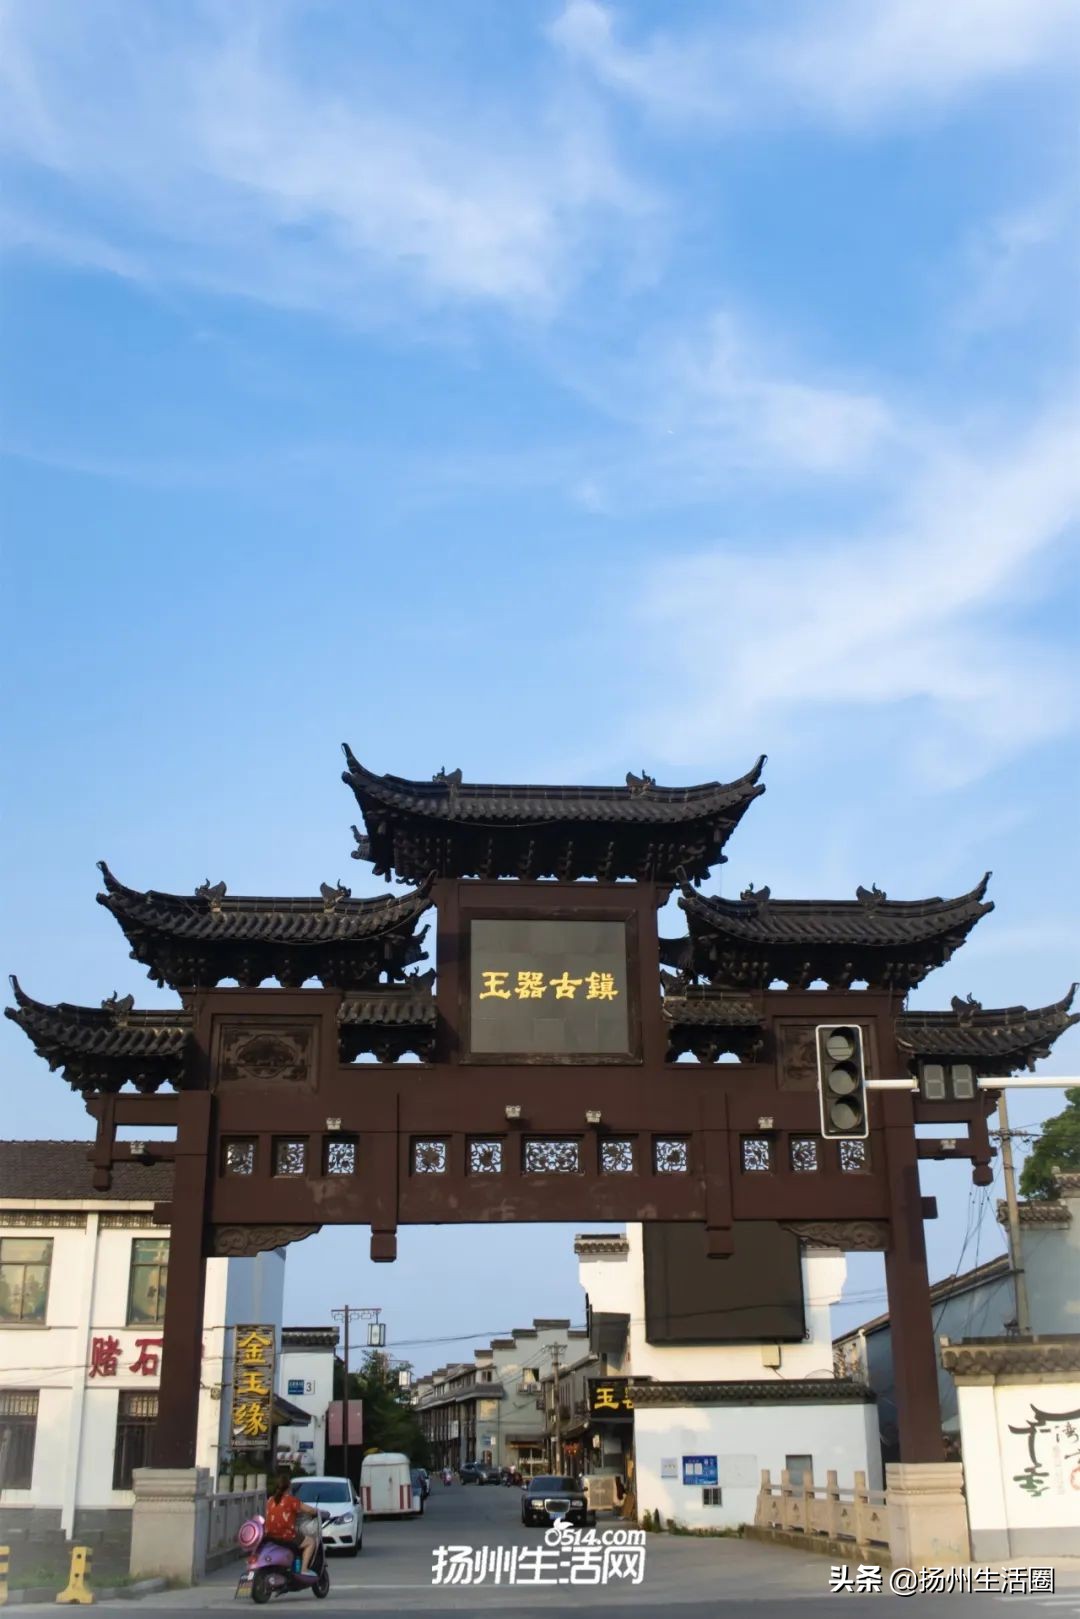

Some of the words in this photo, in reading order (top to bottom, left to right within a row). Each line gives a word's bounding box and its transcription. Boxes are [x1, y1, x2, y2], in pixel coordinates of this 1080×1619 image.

[233, 1331, 271, 1436] 金玉缘
[306, 1382, 312, 1392] 3
